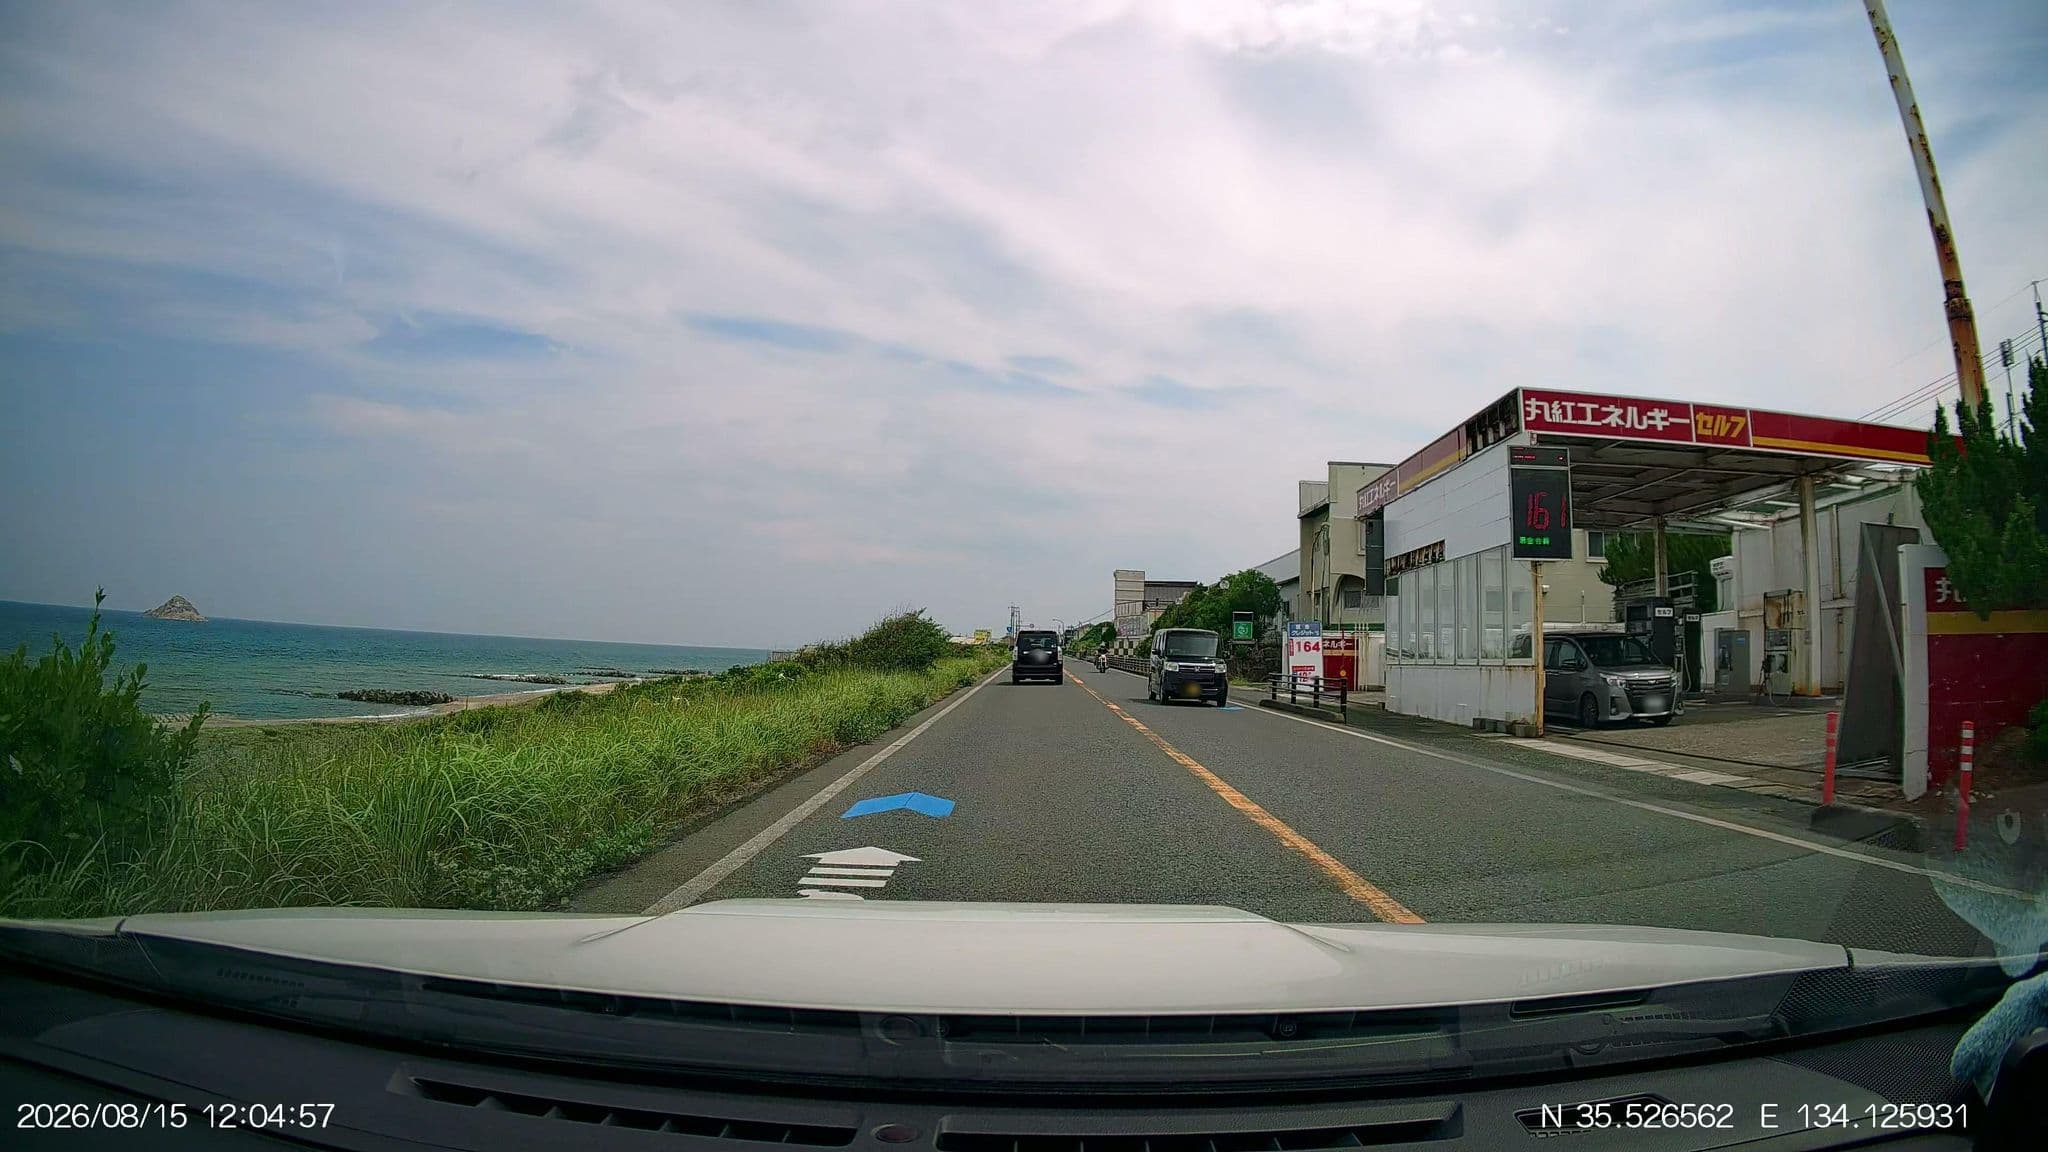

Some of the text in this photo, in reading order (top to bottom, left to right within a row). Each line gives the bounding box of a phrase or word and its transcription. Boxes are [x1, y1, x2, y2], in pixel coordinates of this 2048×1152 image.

[1525, 398, 1690, 431] 丸紅エネルギー
[1696, 412, 1746, 438] セルフ
[1527, 491, 1566, 530] 161
[1296, 641, 1320, 652] 164
